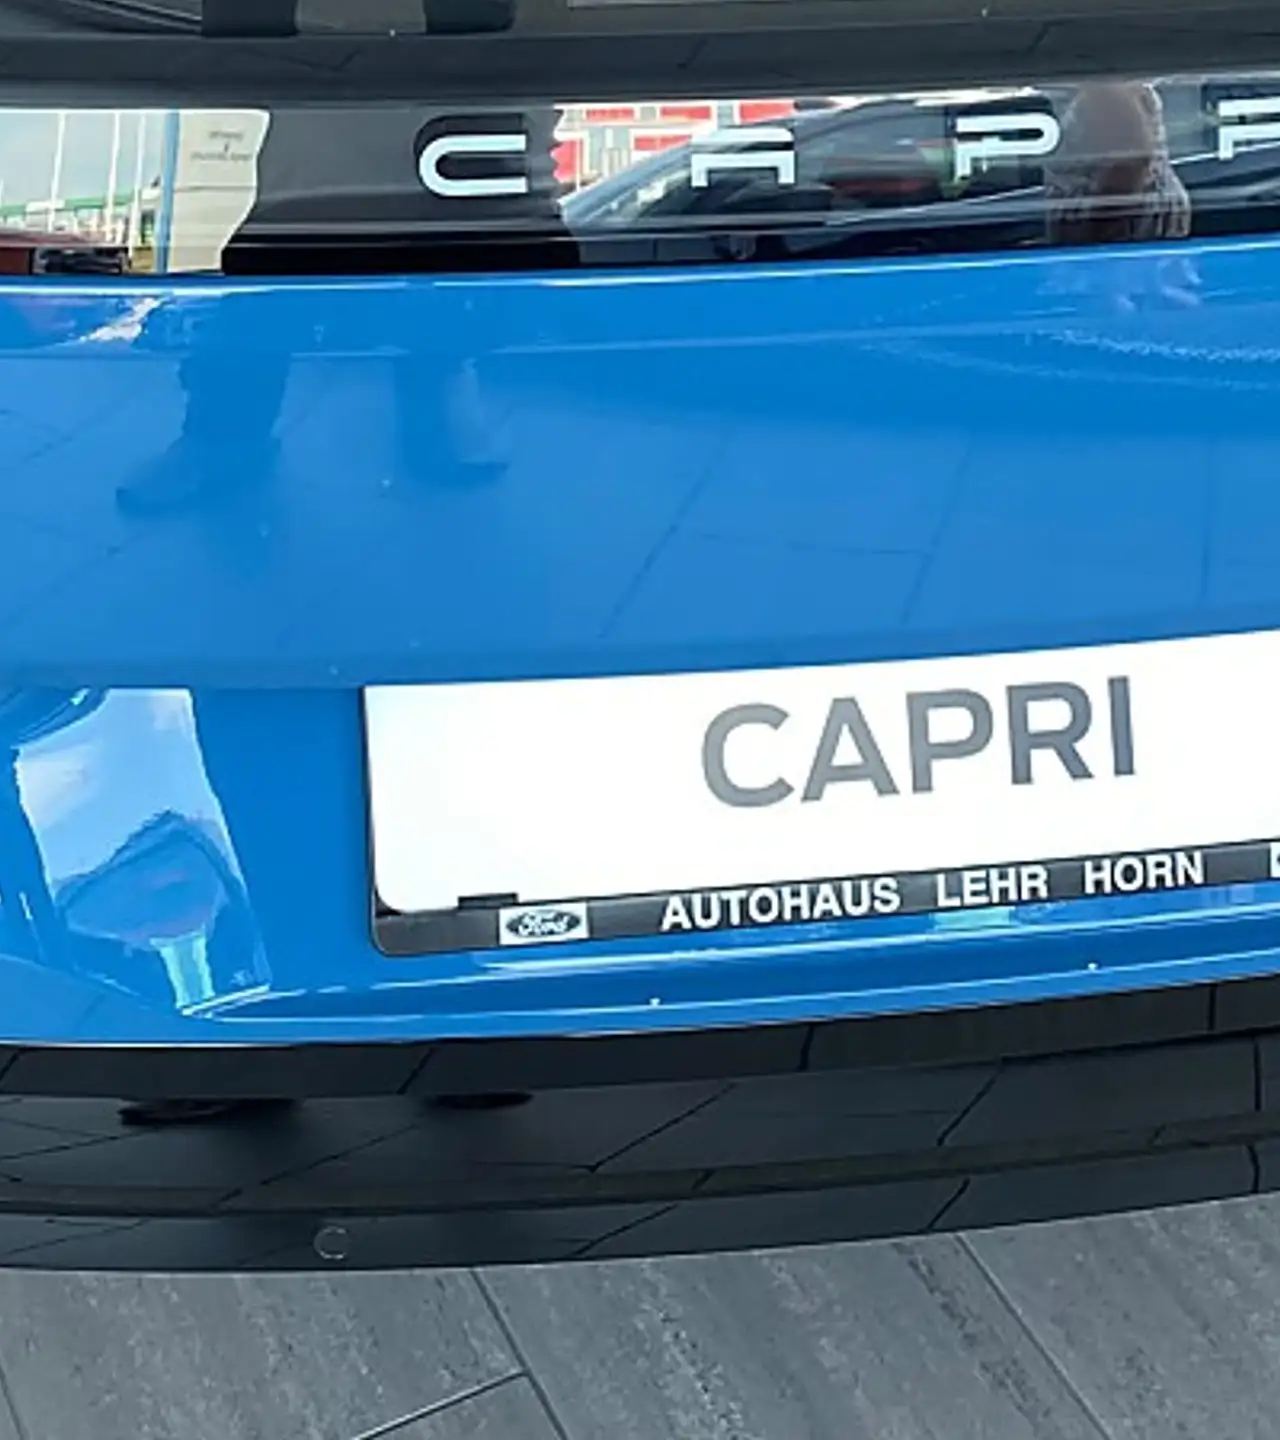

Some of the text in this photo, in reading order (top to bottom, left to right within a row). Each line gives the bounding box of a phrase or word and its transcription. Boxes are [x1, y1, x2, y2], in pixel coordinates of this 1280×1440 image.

[701, 675, 1136, 808] CAPRI
[660, 877, 901, 932] AUTOHAUS
[936, 864, 1050, 907] LEHR
[1084, 851, 1204, 895] HORN
